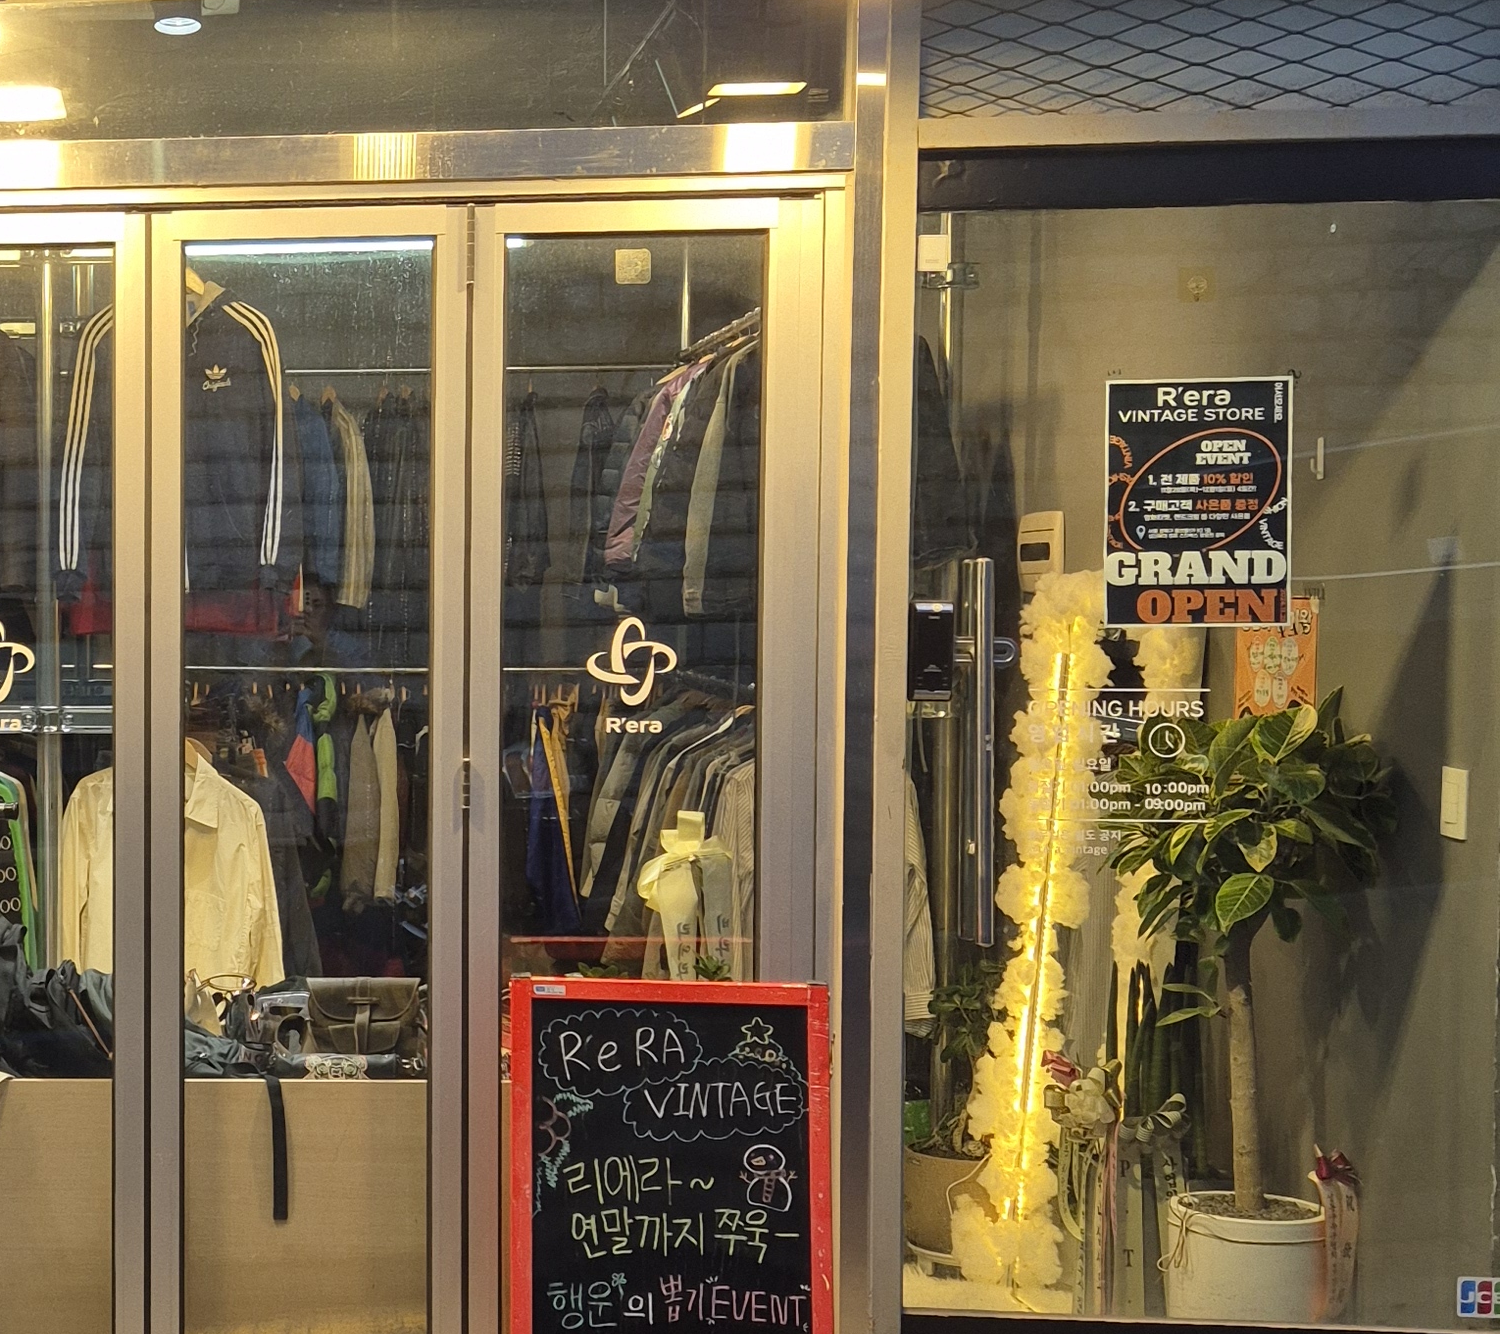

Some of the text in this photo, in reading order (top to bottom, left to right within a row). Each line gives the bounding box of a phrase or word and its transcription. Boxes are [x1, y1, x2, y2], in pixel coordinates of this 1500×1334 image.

[1157, 387, 1231, 407] R'era
[1118, 407, 1265, 423] VINTAGE STORE
[1200, 439, 1247, 452] OPEN
[1196, 452, 1251, 465] EVENT
[1148, 474, 1157, 485] 1.
[1161, 473, 1173, 485] 전
[1203, 473, 1227, 484] 10%
[1230, 473, 1253, 484] 할인
[1128, 500, 1140, 512] 2.
[1143, 499, 1193, 512] 구매고객
[1259, 518, 1284, 550] VINTAGE
[1105, 550, 1287, 585] GRAND
[1137, 588, 1279, 623] OPEN
[1128, 699, 1204, 717] HOURS
[606, 717, 663, 733] R'era
[1145, 798, 1206, 813] 09:00pm
[1099, 829, 1121, 842] 공지
[644, 1081, 797, 1119] VINTAGE
[571, 1206, 704, 1258] 연말까지
[659, 1273, 704, 1322] 뽑기
[712, 1284, 807, 1327] EVENT
